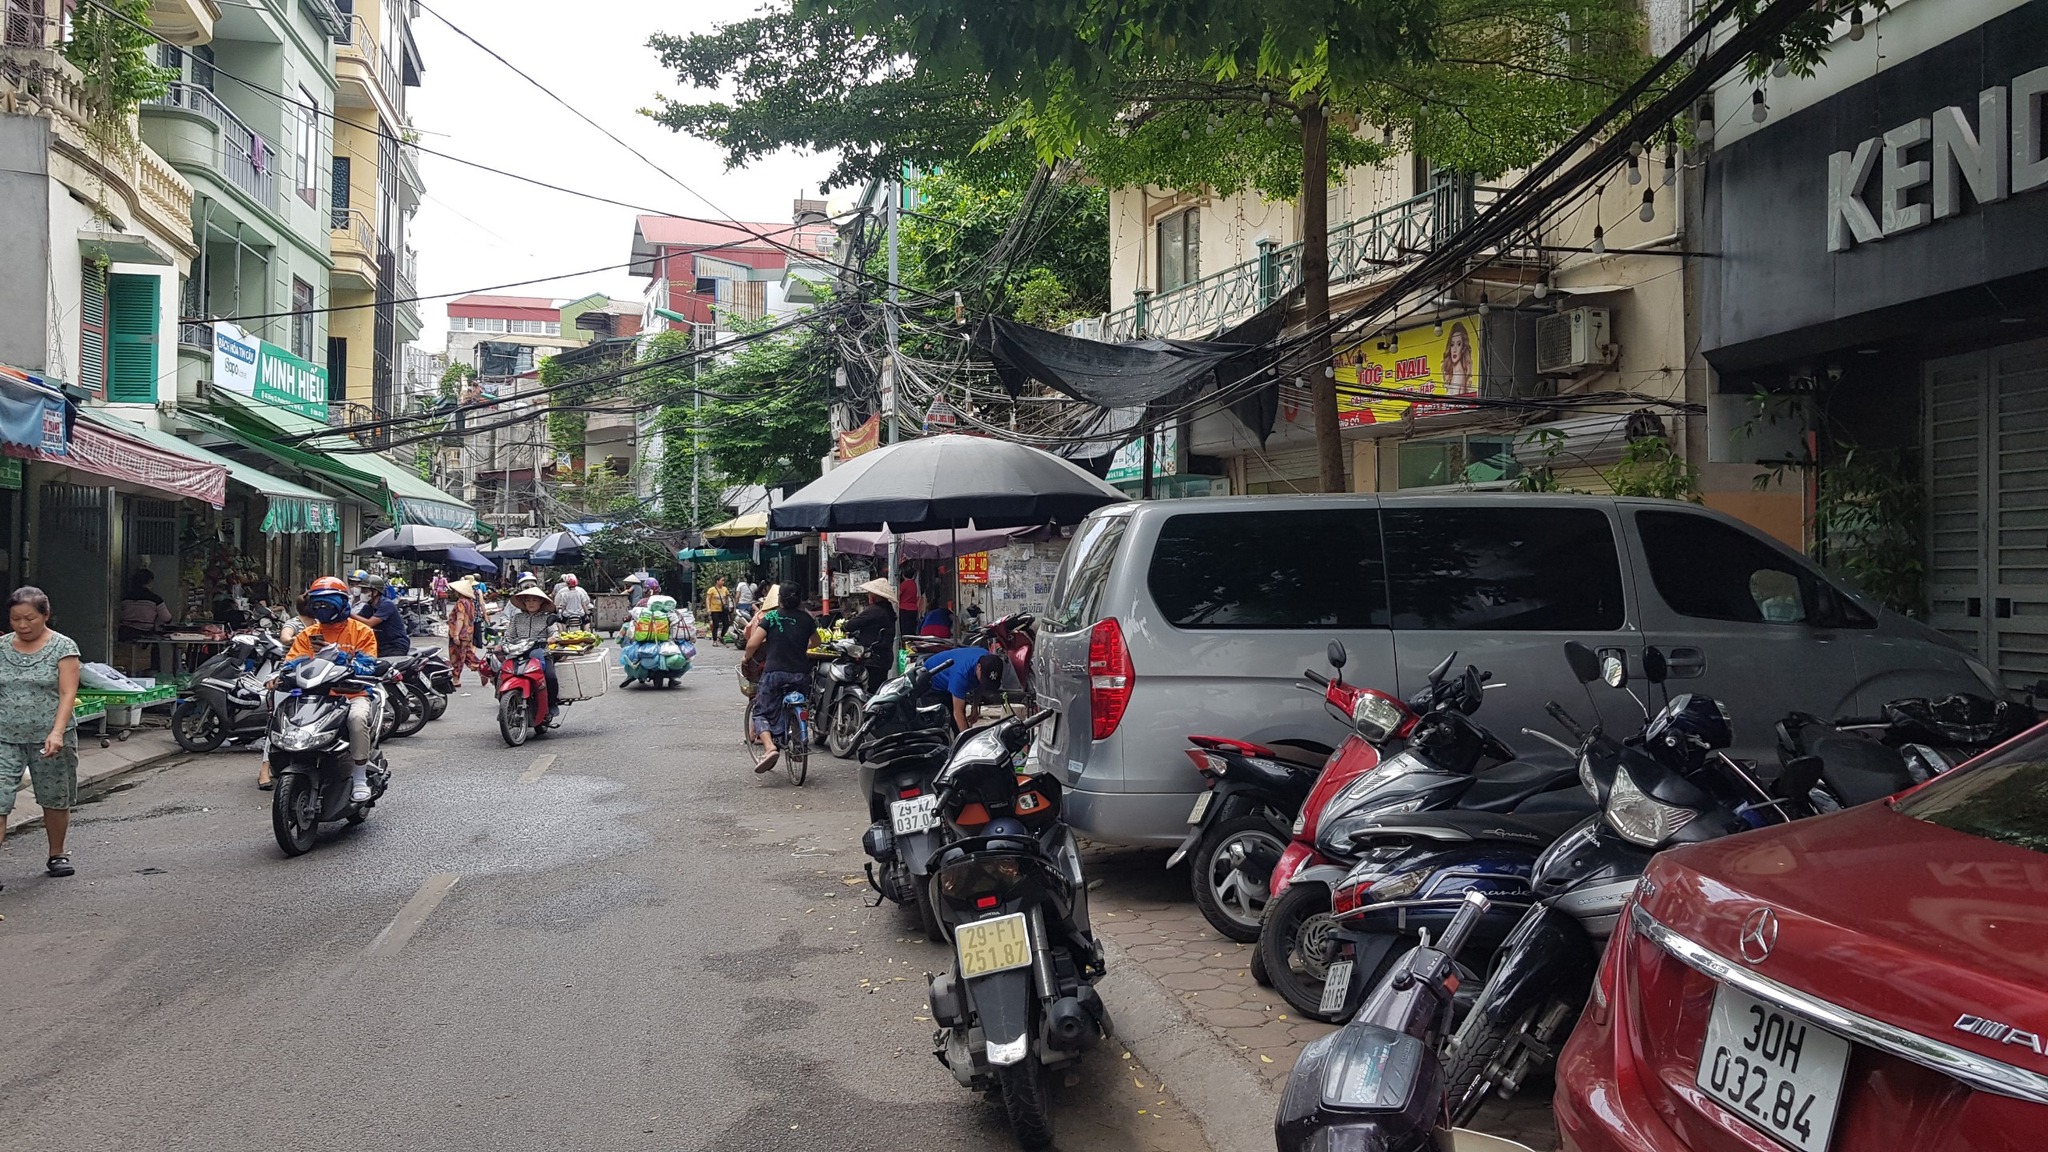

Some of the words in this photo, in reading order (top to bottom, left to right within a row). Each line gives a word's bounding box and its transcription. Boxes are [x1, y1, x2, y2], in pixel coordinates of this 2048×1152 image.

[262, 352, 296, 396] MINH
[298, 367, 325, 405] HIẾU
[1396, 356, 1430, 381] NAIL
[966, 919, 1017, 950] 29-F1
[964, 940, 1024, 974] 251.87
[1743, 1004, 1807, 1074] 30H
[1710, 1045, 1816, 1144] 032.84
